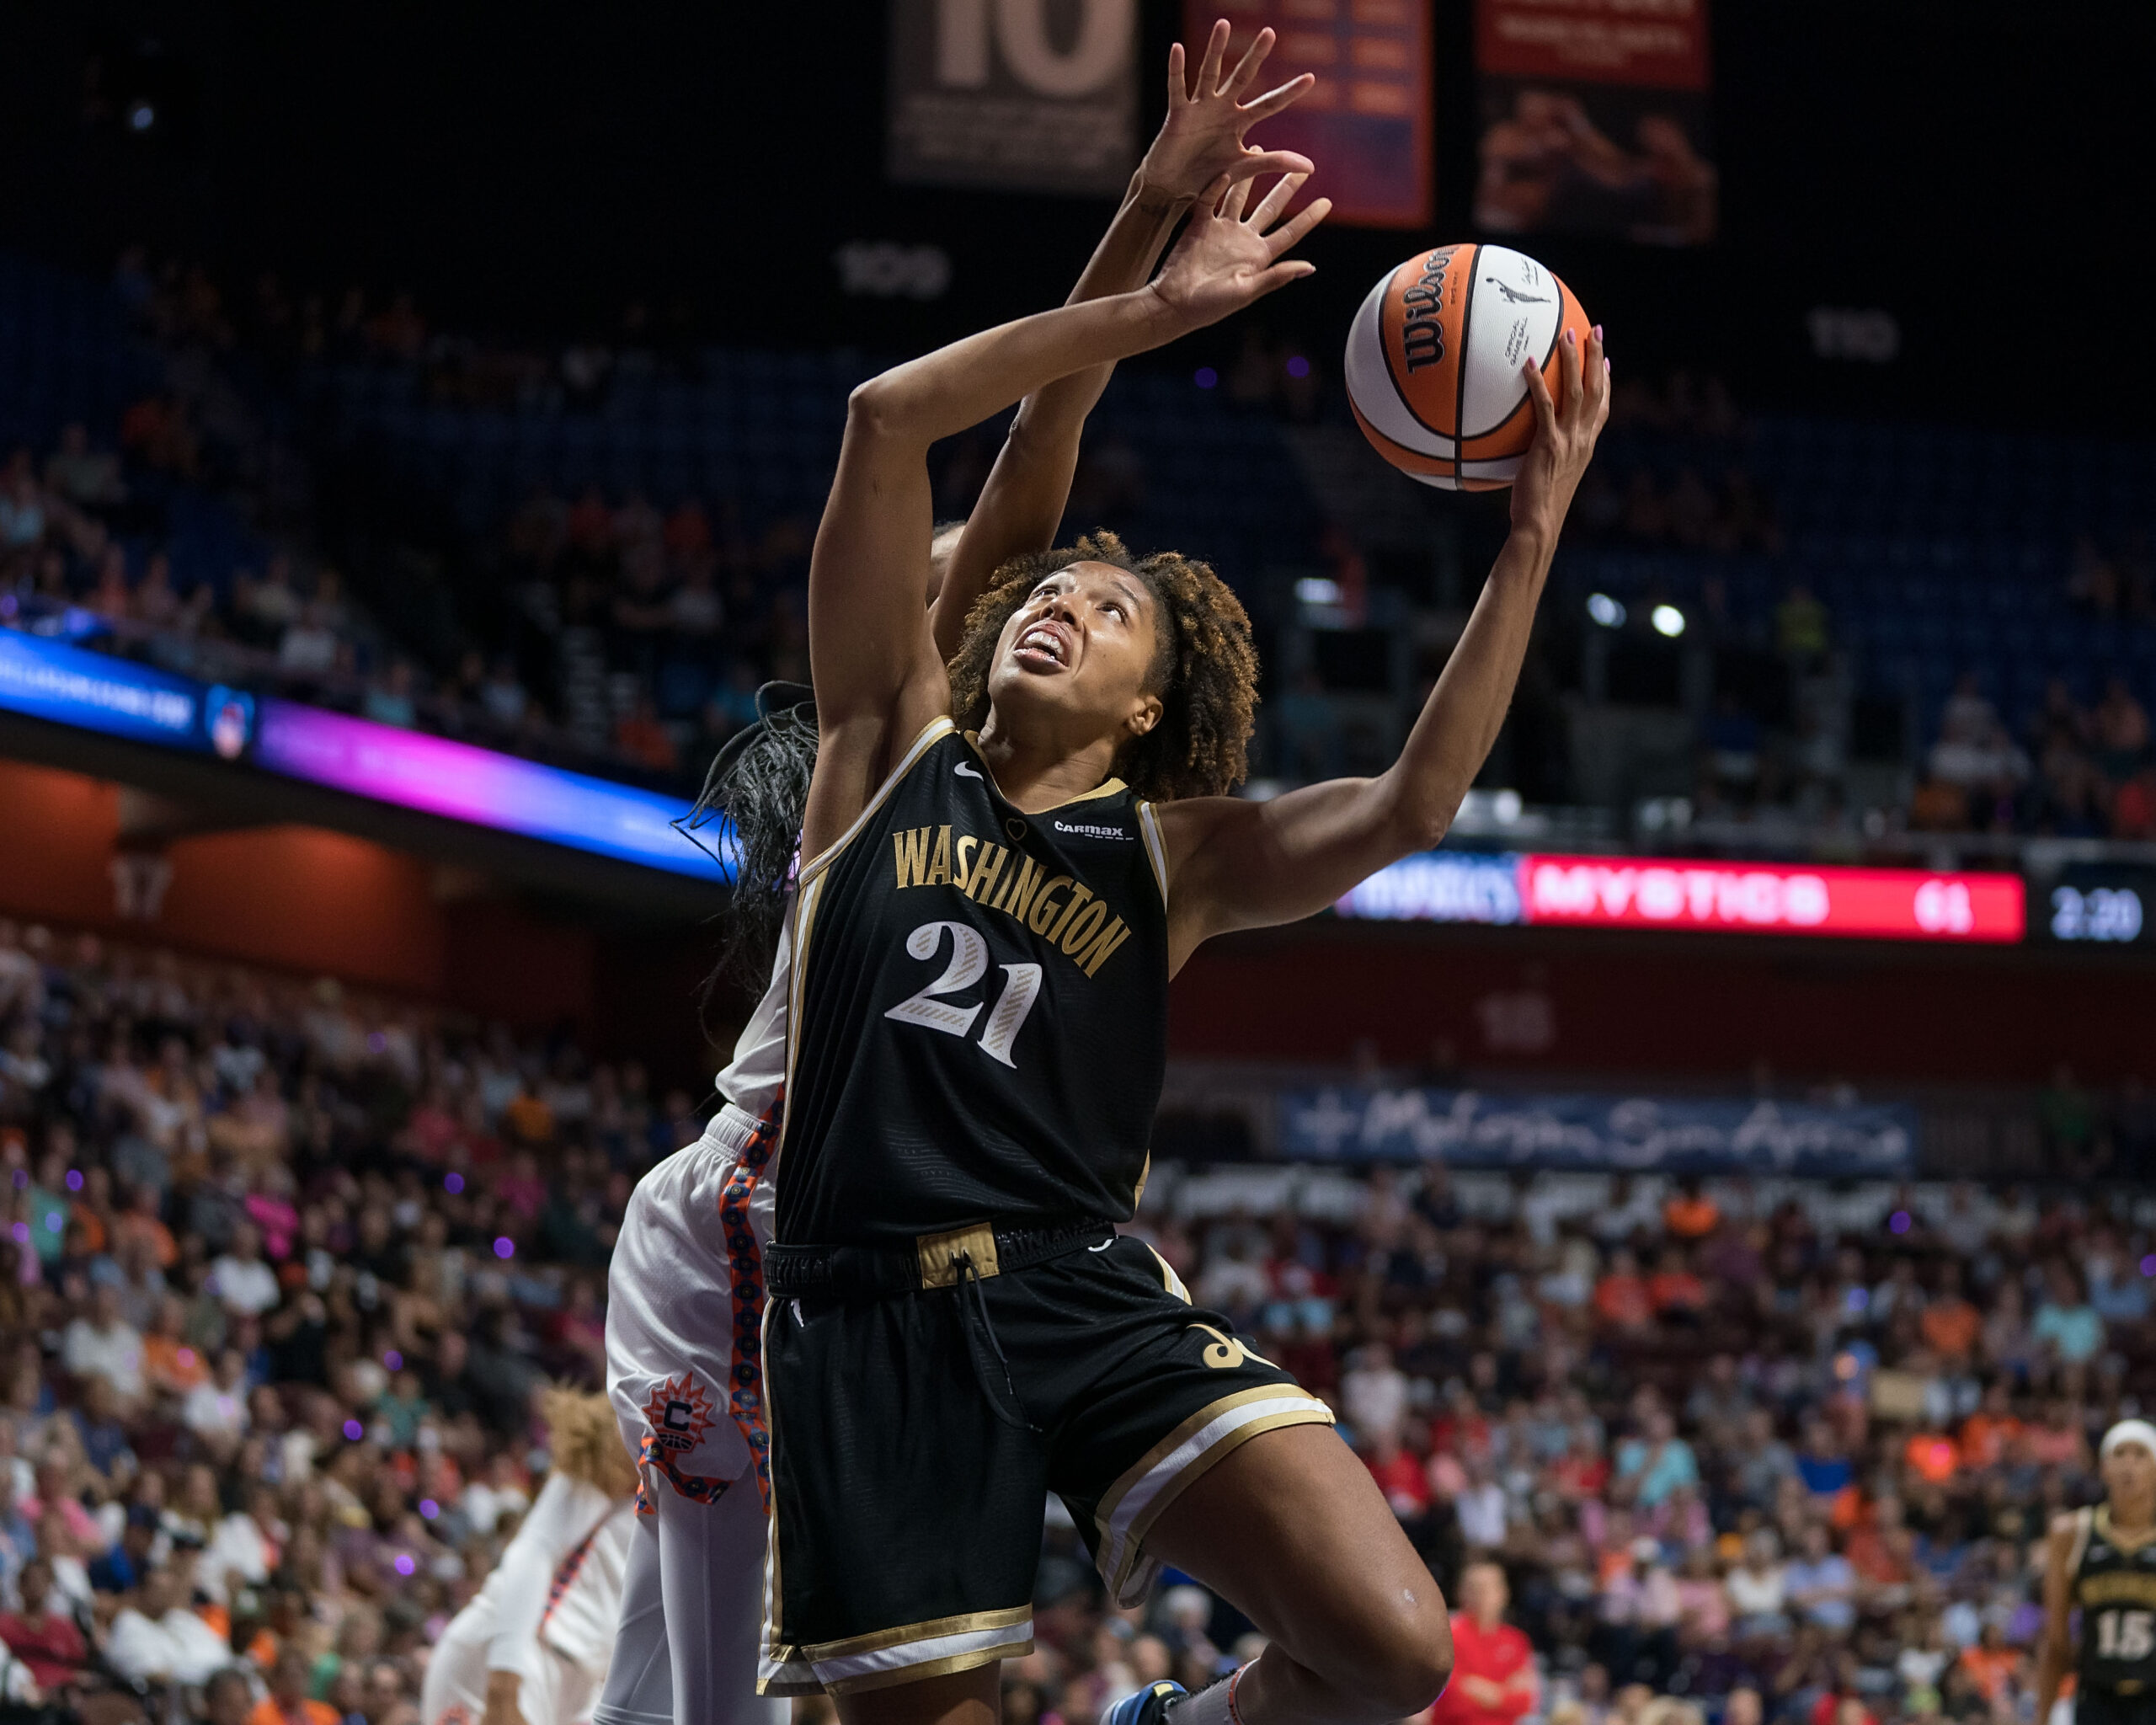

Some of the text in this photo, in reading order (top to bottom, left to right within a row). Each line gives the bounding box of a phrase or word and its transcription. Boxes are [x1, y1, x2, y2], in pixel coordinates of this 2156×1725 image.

[892, 824, 1132, 980] WASHINGTON
[1532, 863, 1829, 927] MYSTICS
[883, 920, 1043, 1070] 21
[663, 1400, 693, 1432] C
